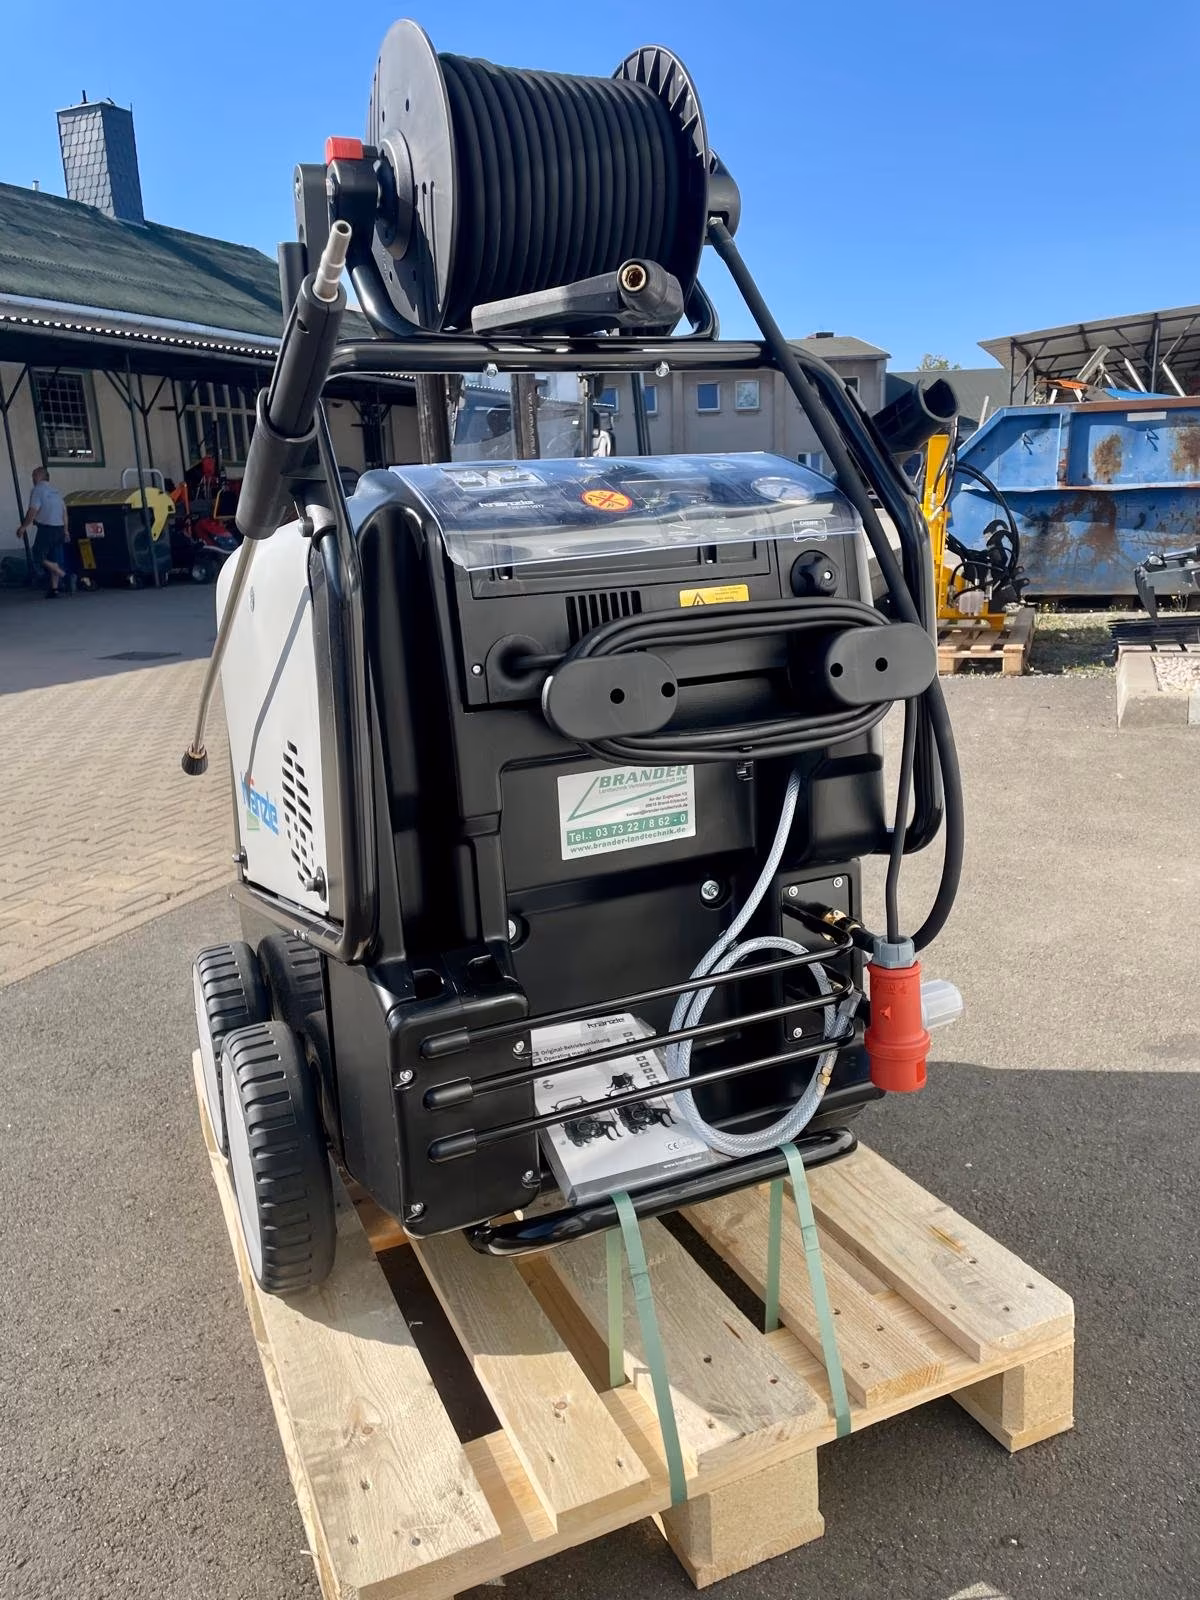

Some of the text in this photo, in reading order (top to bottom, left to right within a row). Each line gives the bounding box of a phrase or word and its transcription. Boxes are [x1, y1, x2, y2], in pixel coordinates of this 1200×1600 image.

[599, 765, 689, 788] BRANDER
[569, 832, 592, 843] Tel.:
[595, 827, 608, 838] 03
[612, 824, 625, 835] 73
[627, 821, 639, 832] 22
[642, 820, 646, 829] /
[649, 818, 655, 828] 8
[658, 816, 670, 826] 62
[680, 813, 686, 823] 0
[570, 826, 687, 854] www.brander-landtechnik.de
